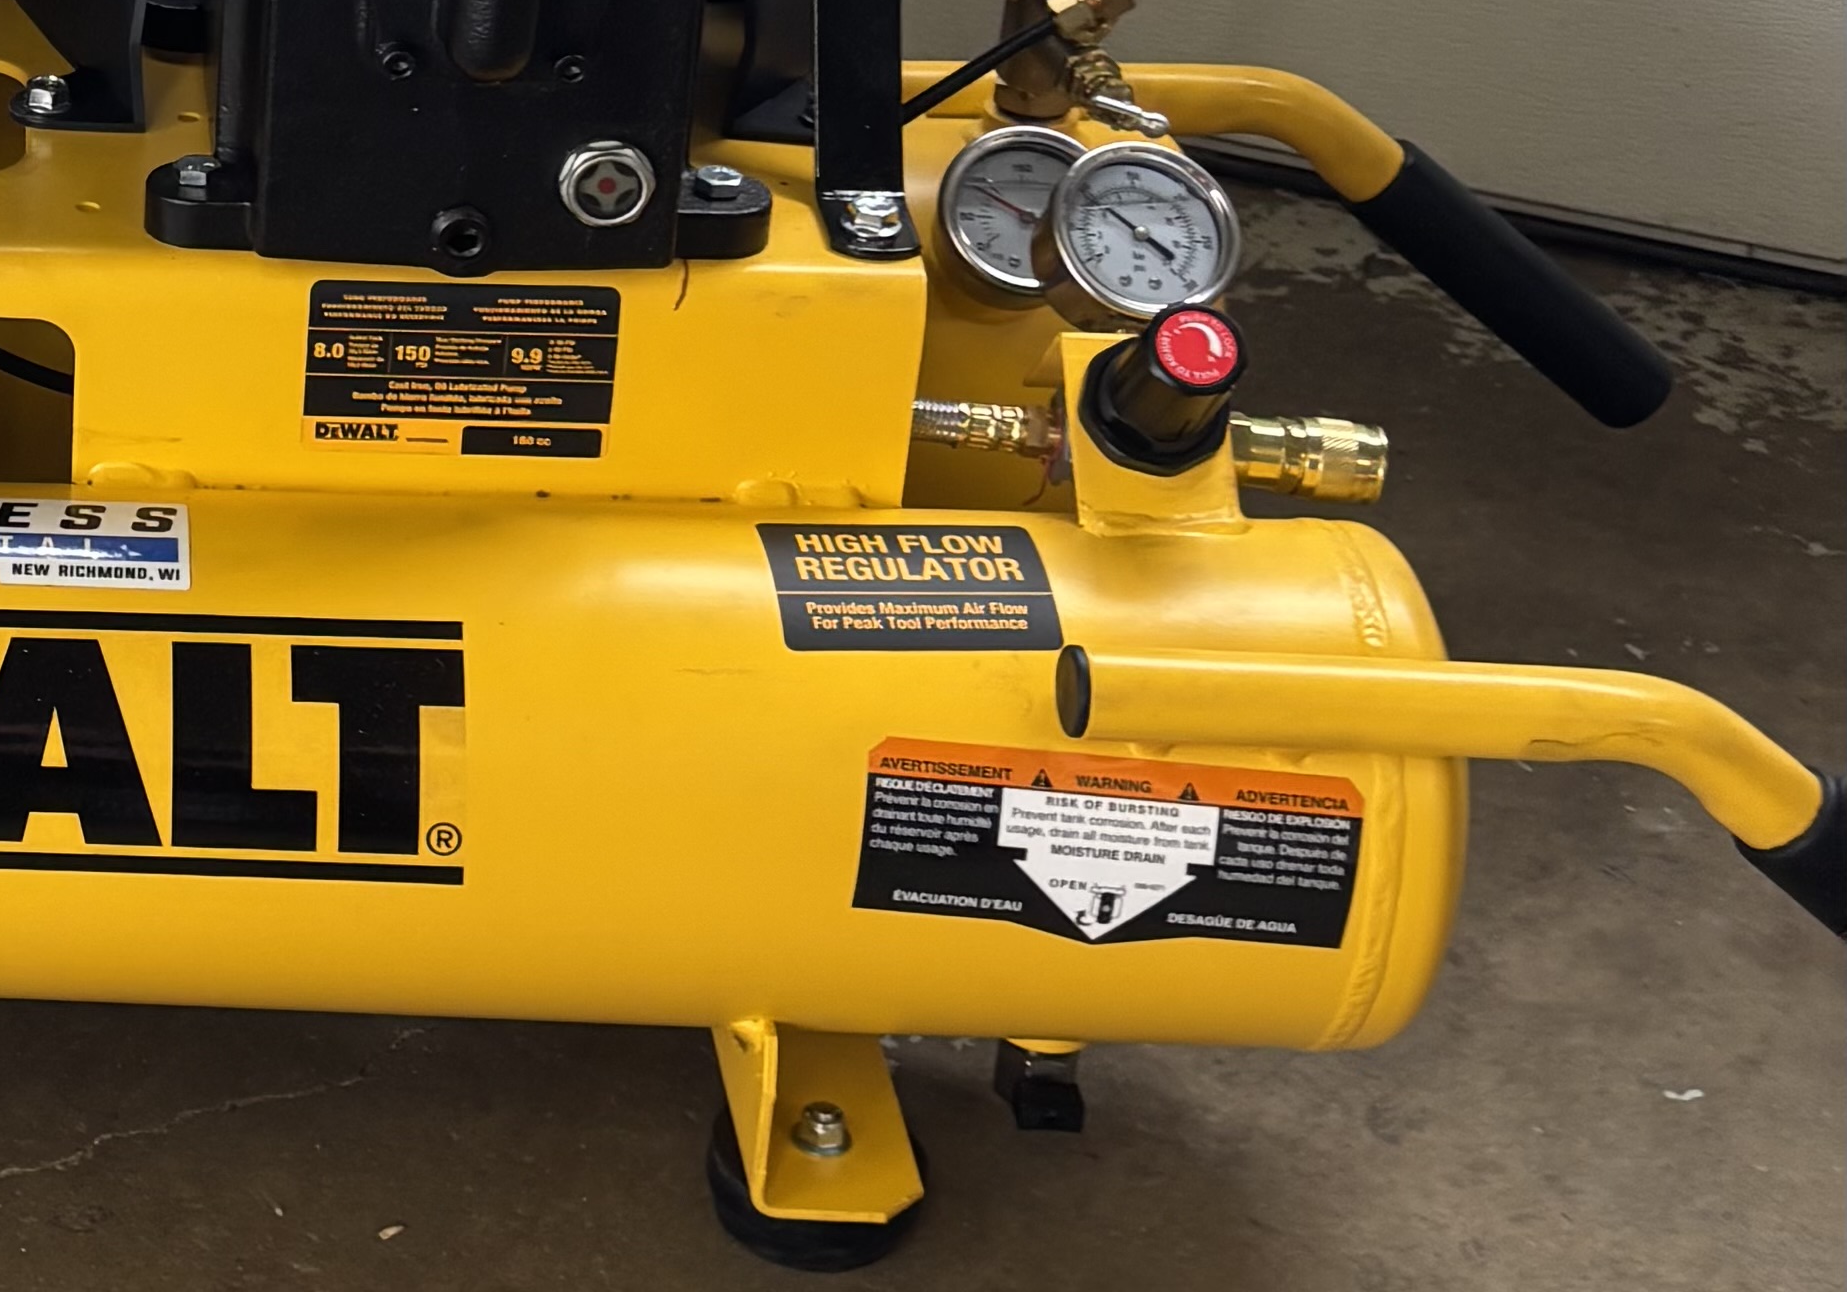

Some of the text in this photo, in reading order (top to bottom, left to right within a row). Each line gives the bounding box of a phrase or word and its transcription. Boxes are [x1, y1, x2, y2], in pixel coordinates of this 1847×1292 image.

[313, 342, 345, 358] 8.0
[395, 344, 432, 361] 150
[511, 347, 544, 364] 9.9
[794, 533, 1004, 555] HIGH FLOW
[11, 563, 51, 578] NEW
[157, 568, 181, 581] WI
[795, 556, 1025, 582] REGULATOR
[805, 601, 1029, 616] Provides Maximum Air Flow
[812, 617, 1029, 631] For Peak Tool Performance
[879, 756, 1013, 780] AVERTISSEMENT
[1075, 775, 1152, 794] WARNING
[1045, 796, 1180, 817] RISK OF BURSTING
[1236, 789, 1350, 812] ADVERTENCIA
[1011, 806, 1058, 822] Prevent
[1061, 811, 1086, 824] tank
[1150, 819, 1178, 833] After
[1181, 823, 1212, 836] each
[1049, 826, 1080, 839] drain
[1082, 829, 1097, 840] all
[1100, 831, 1151, 846] moisture
[1153, 835, 1181, 848] from
[1050, 844, 1166, 864] MOISTURE DRAIN
[1048, 878, 1087, 890] OPEN
[892, 887, 1024, 912] ÉVACUATION D'EAU
[1166, 911, 1298, 935] DESAGÜE DE AGUA
